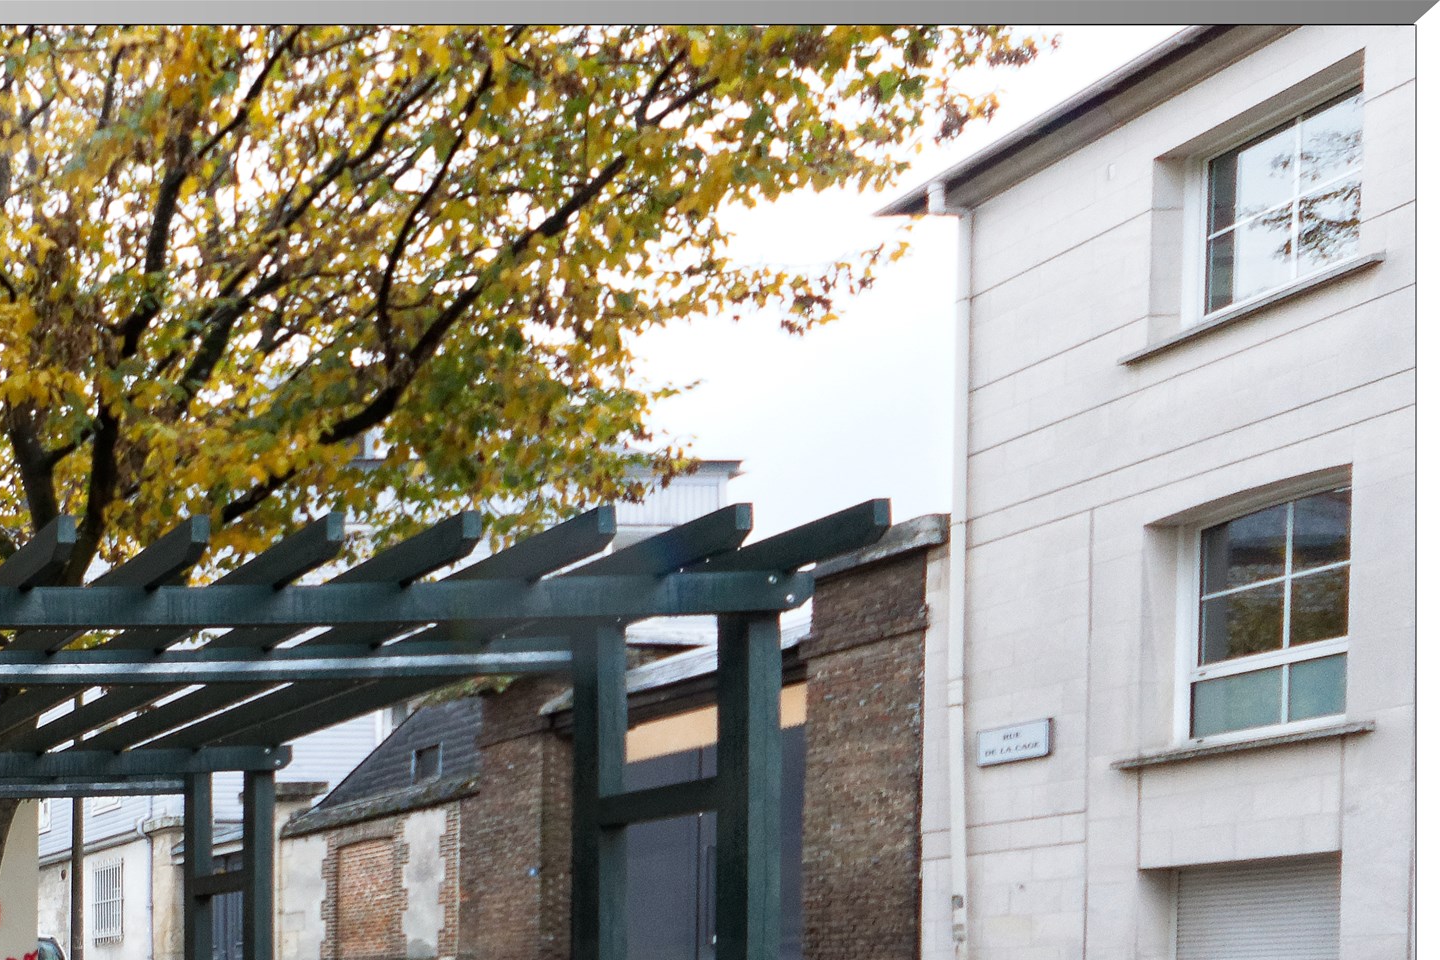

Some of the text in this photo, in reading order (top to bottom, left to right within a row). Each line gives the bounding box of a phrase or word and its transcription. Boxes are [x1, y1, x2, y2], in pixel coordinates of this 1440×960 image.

[1003, 731, 1021, 741] RUE
[985, 749, 996, 757] DE
[1000, 746, 1012, 755] LA
